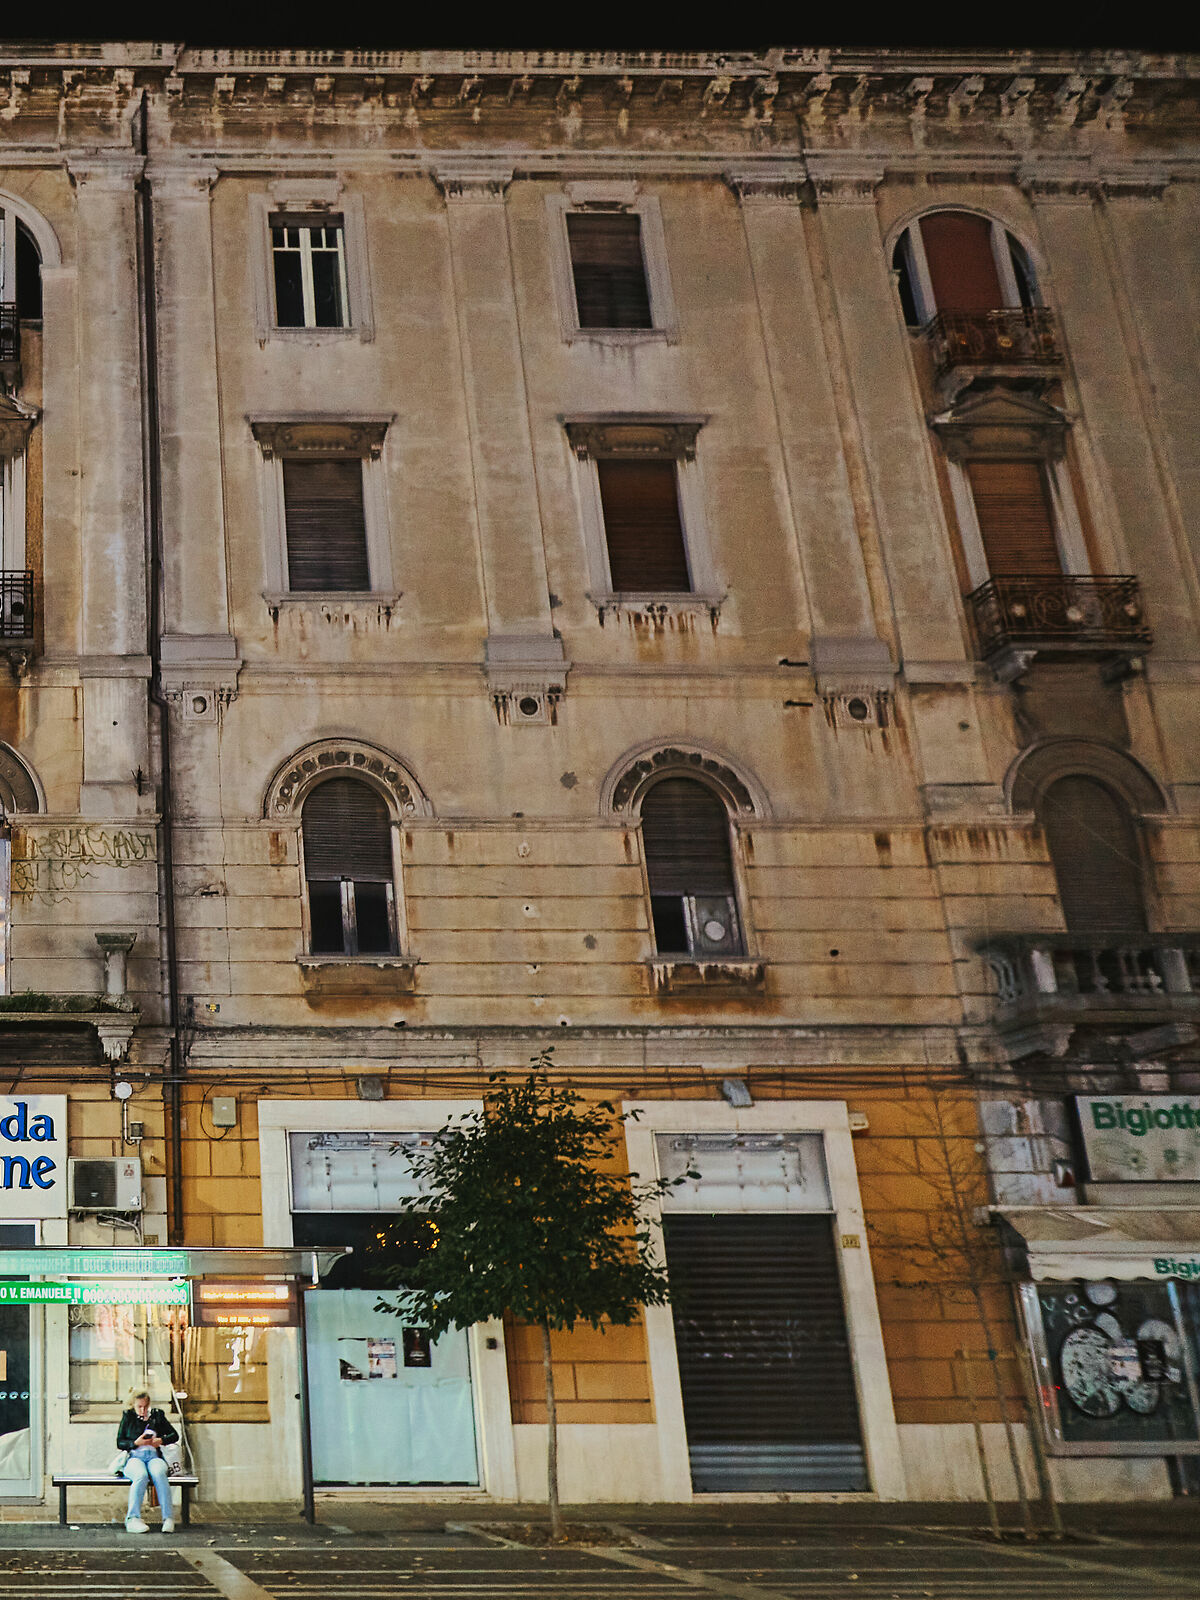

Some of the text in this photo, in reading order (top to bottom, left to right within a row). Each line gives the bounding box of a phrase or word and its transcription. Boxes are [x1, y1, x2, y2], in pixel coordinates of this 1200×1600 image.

[1090, 1102, 1200, 1136] Bigiott
[1153, 1257, 1200, 1279] Bigi
[9, 1288, 18, 1299] V.
[19, 1287, 72, 1299] EMANUELE
